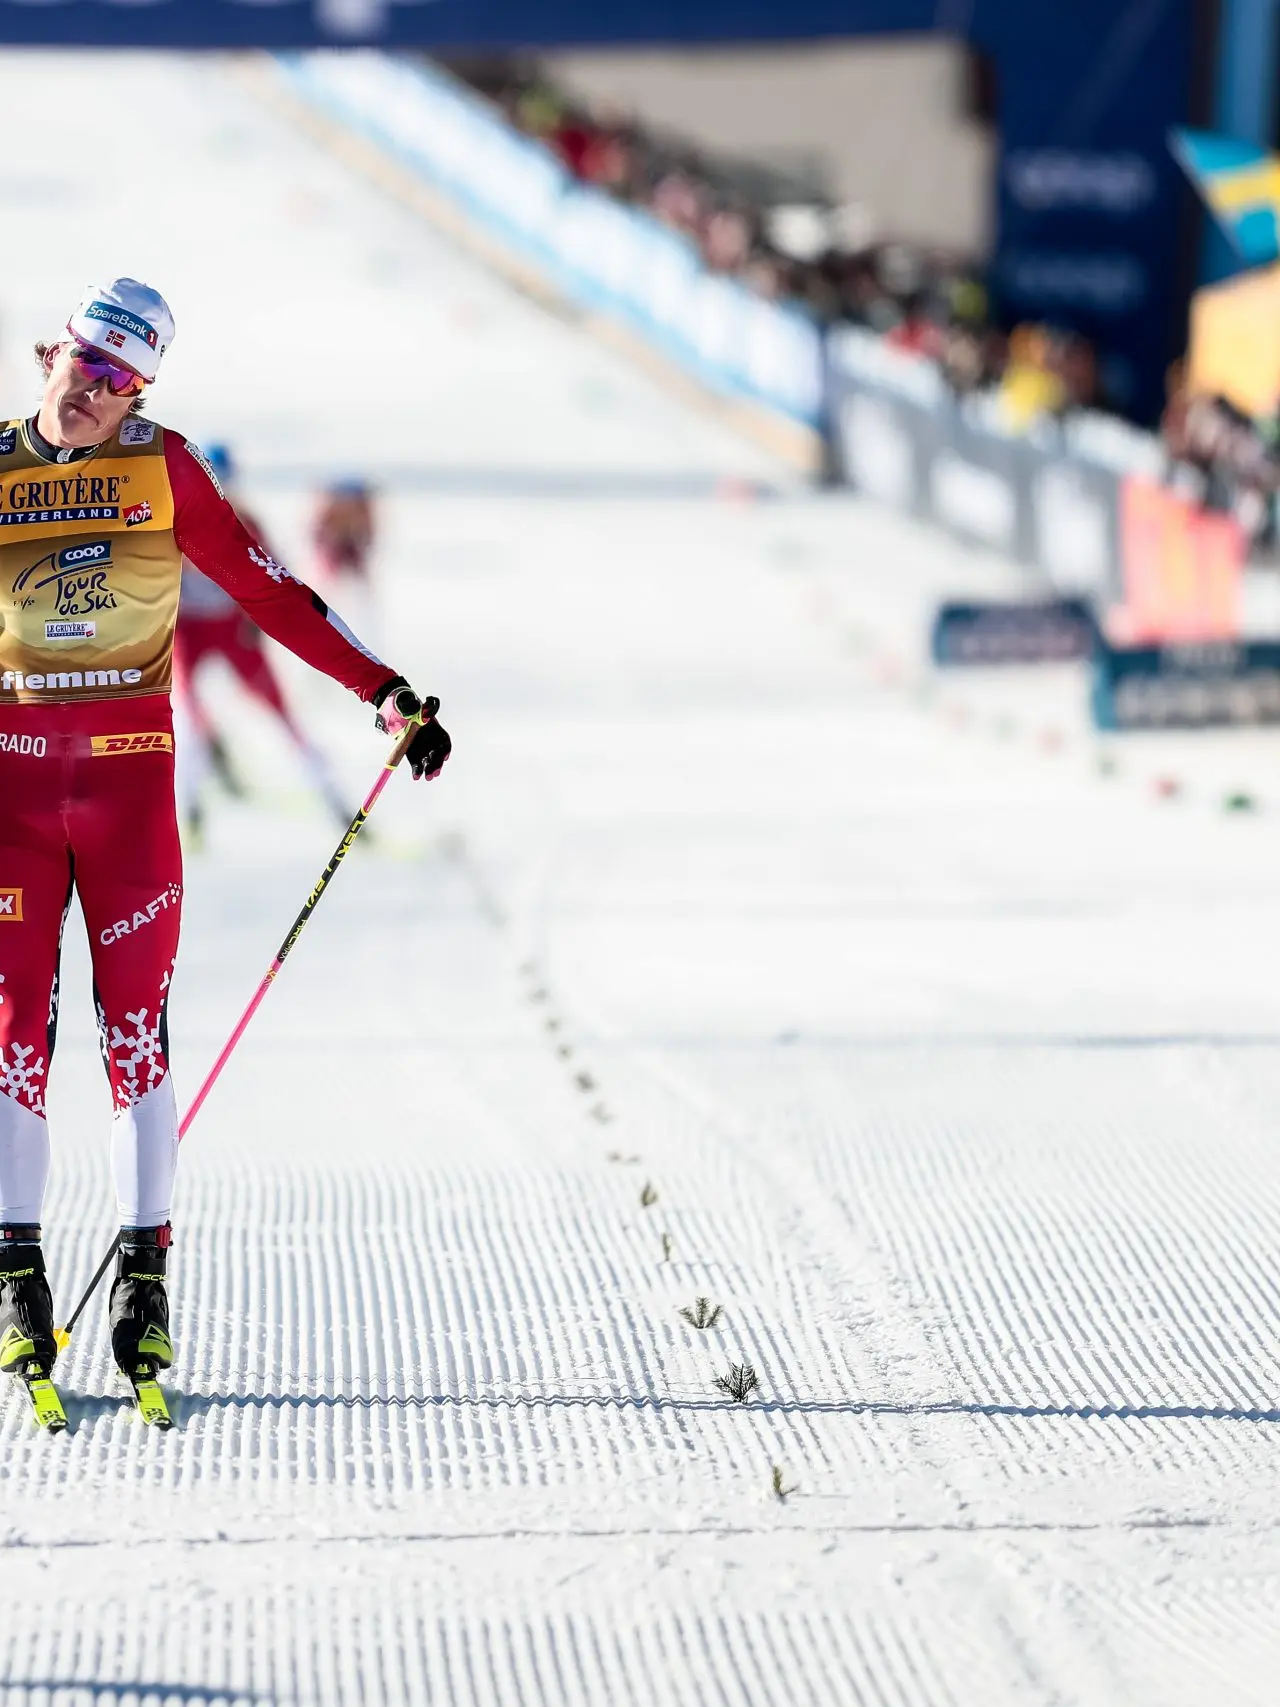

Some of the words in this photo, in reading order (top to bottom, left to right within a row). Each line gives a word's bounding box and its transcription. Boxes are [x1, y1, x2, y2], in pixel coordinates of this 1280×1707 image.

[88, 304, 147, 337] SpareBank
[125, 509, 151, 522] AOP
[64, 545, 105, 560] coop
[59, 600, 79, 615] de
[47, 624, 55, 632] LE
[0, 668, 142, 690] fiemme
[105, 735, 167, 752] DHL
[335, 820, 364, 861] LEKI
[306, 866, 332, 909] EKI
[100, 891, 169, 945] CRAFT
